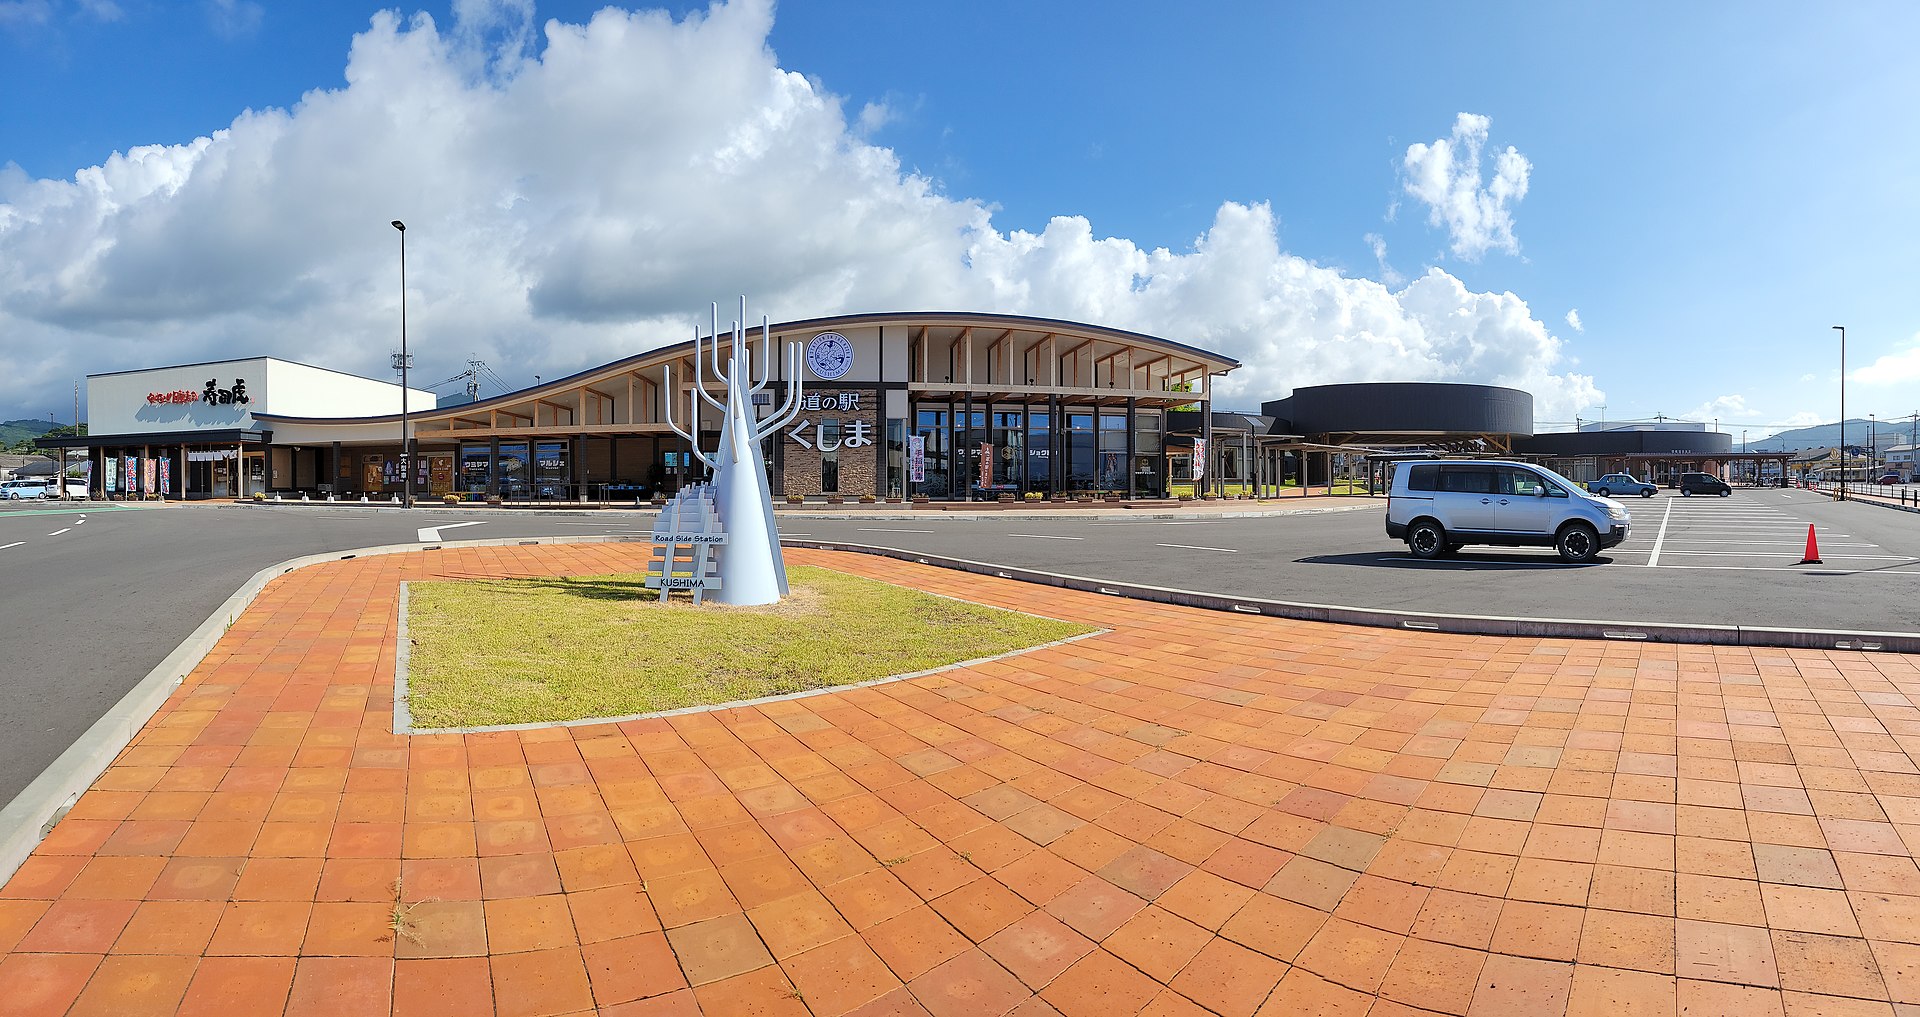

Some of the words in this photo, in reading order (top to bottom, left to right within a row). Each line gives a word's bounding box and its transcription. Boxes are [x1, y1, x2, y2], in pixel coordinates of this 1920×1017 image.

[800, 392, 861, 412] 道の駅
[788, 419, 872, 452] くしま
[655, 534, 674, 542] Road
[694, 535, 723, 543] Station
[660, 578, 705, 588] KUSHIMA
